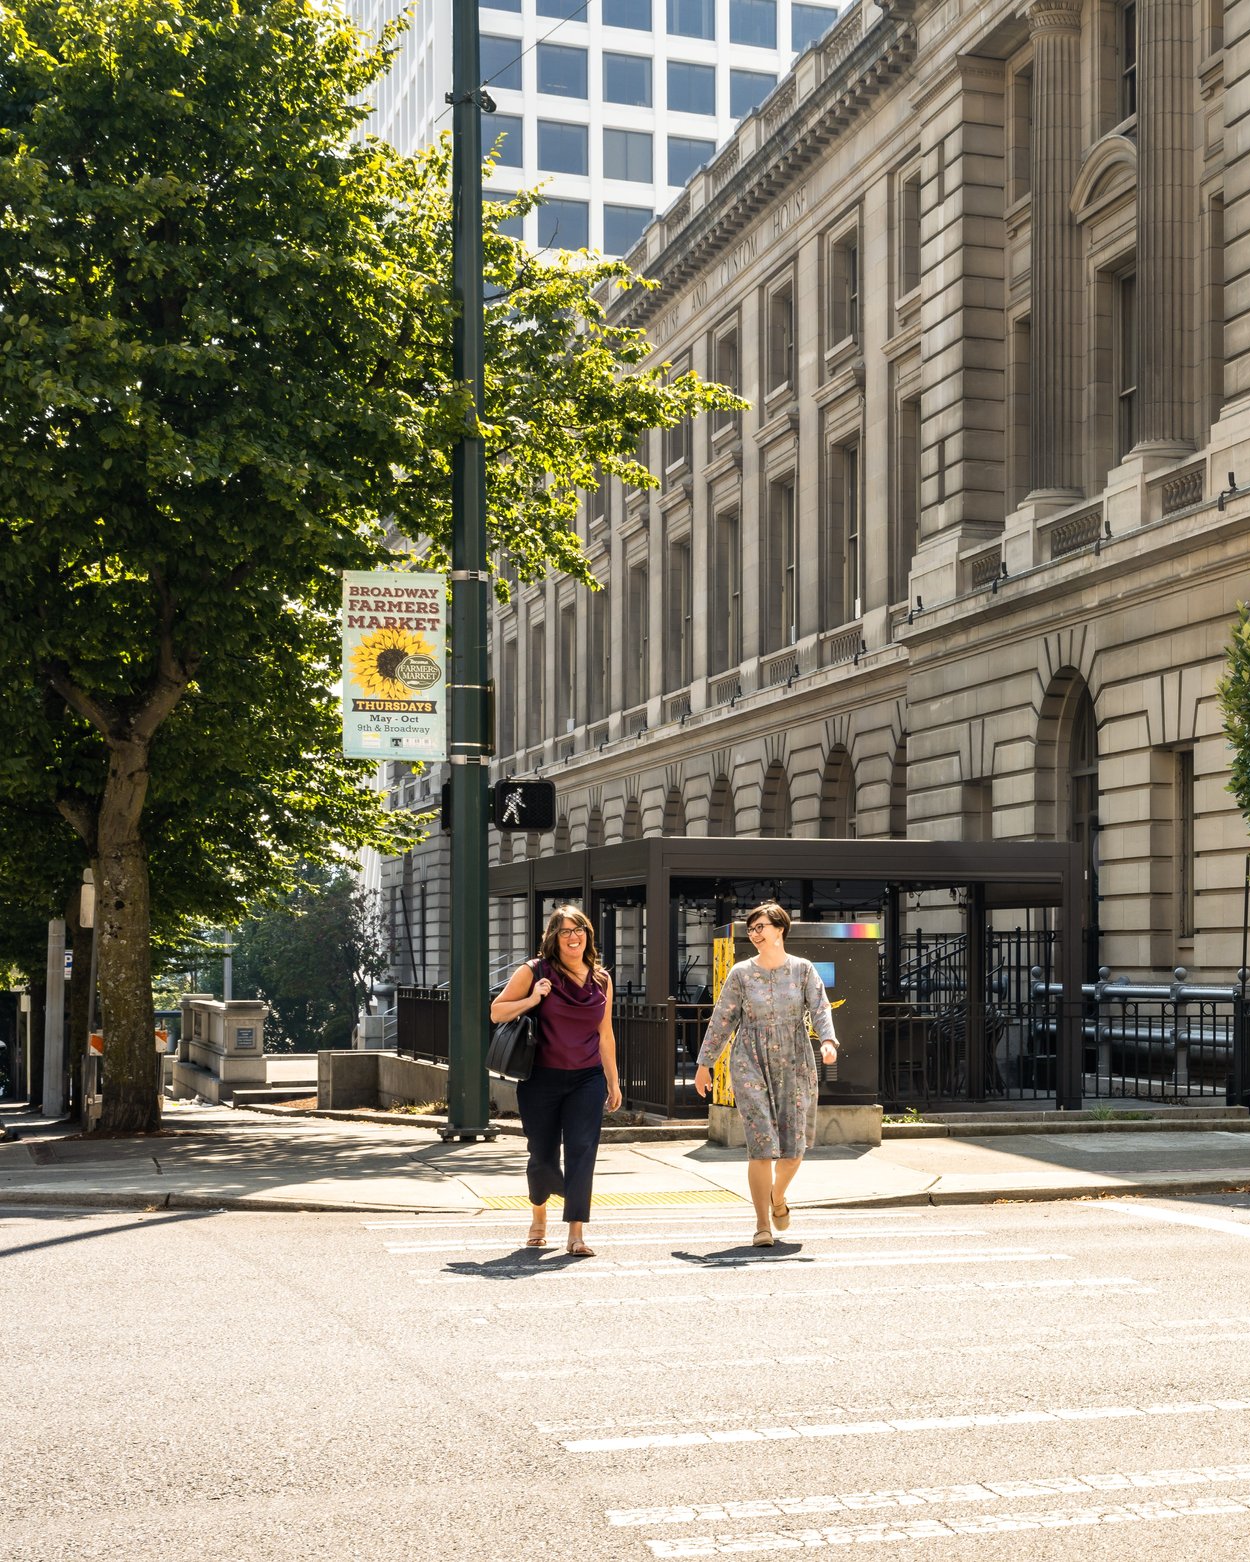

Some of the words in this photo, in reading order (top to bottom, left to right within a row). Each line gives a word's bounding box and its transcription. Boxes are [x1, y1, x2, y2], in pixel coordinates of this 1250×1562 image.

[655, 305, 680, 347] HOUSE
[691, 280, 708, 313] AND
[720, 232, 758, 287] CUSTOM
[772, 185, 807, 238] HOUSE
[349, 586, 439, 599] BROADWAY
[348, 599, 440, 614] FARMERS
[347, 615, 440, 631] MARKET
[400, 664, 437, 673] FARMERS
[403, 672, 436, 680] MARKET
[356, 701, 432, 712] THURSDAYS
[369, 714, 392, 724] May
[401, 715, 419, 723] Oct
[357, 724, 372, 732] 9th
[384, 725, 430, 735] Broadway
